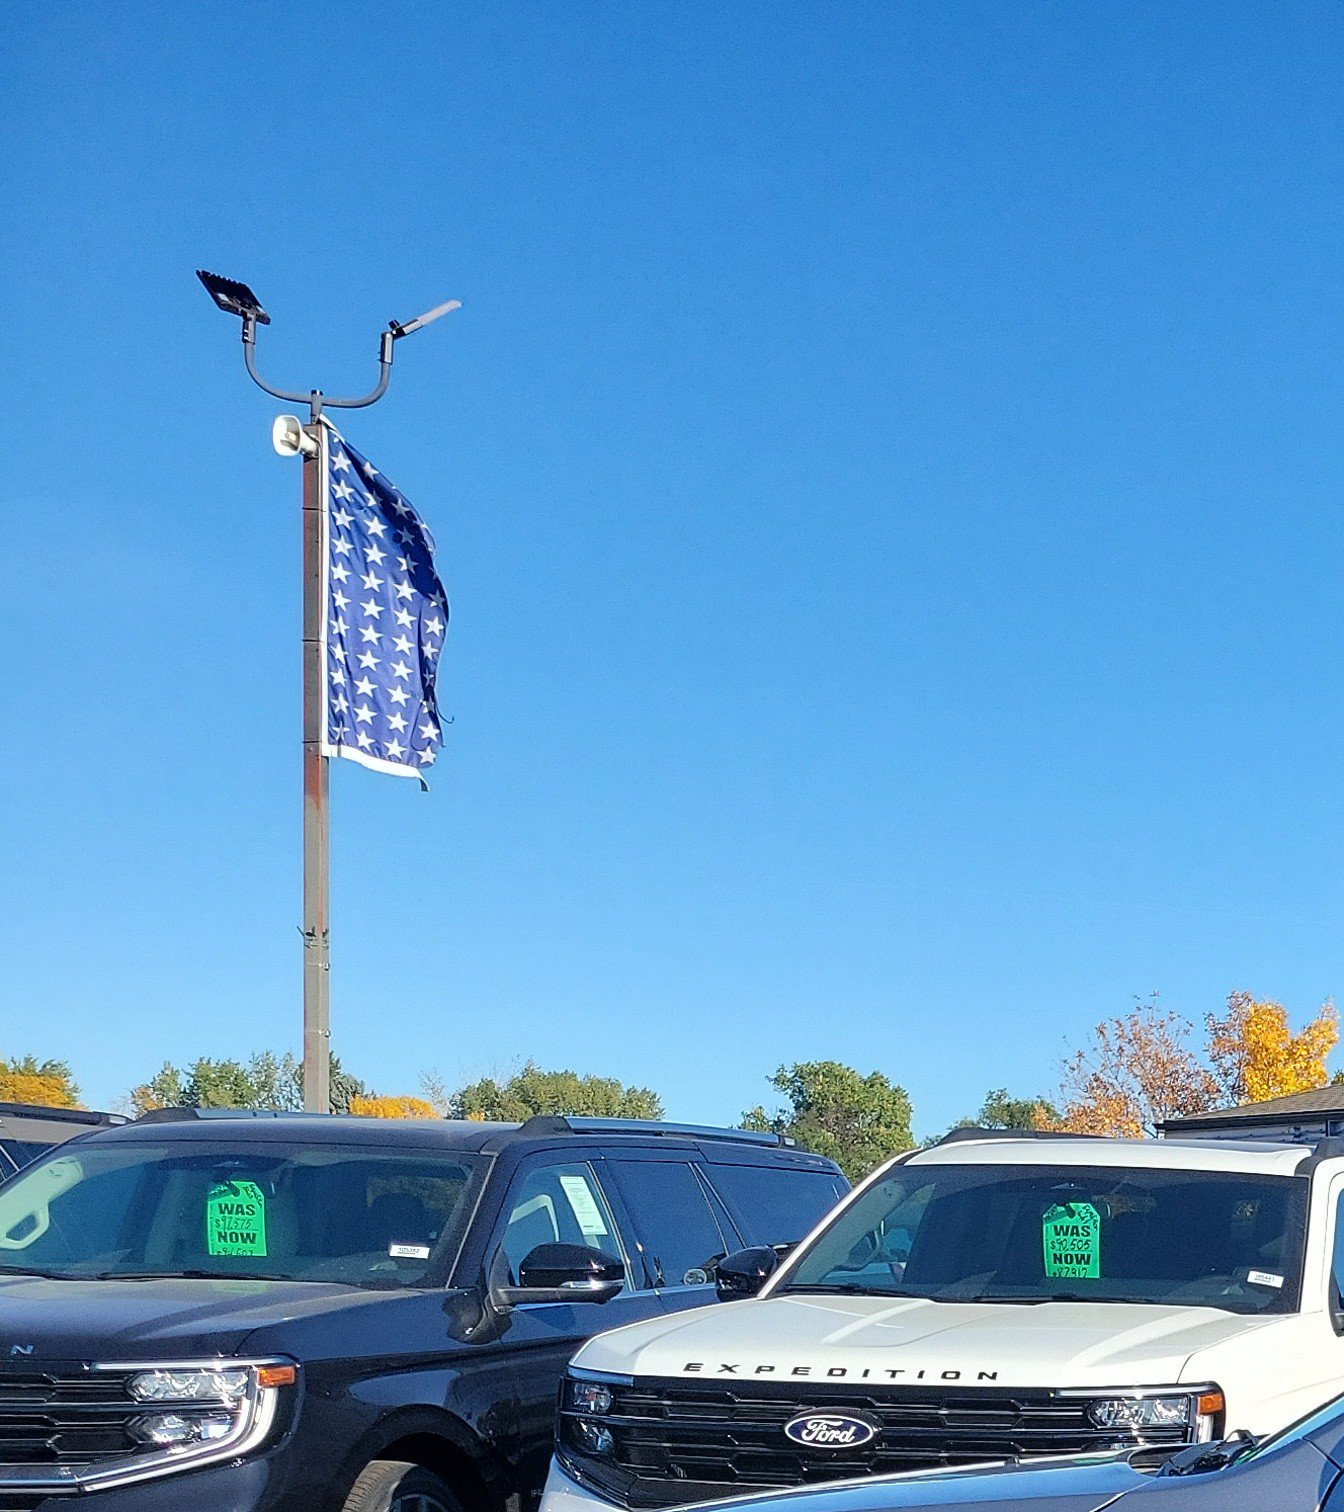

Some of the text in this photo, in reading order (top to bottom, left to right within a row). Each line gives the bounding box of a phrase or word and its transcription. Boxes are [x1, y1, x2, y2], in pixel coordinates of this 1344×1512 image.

[217, 1203, 256, 1216] WAS
[217, 1231, 257, 1244] NOW
[1053, 1225, 1091, 1237] WAS
[1052, 1253, 1092, 1265] NOW
[683, 1362, 998, 1380] EXPEDITION
[801, 1419, 857, 1443] Ford
